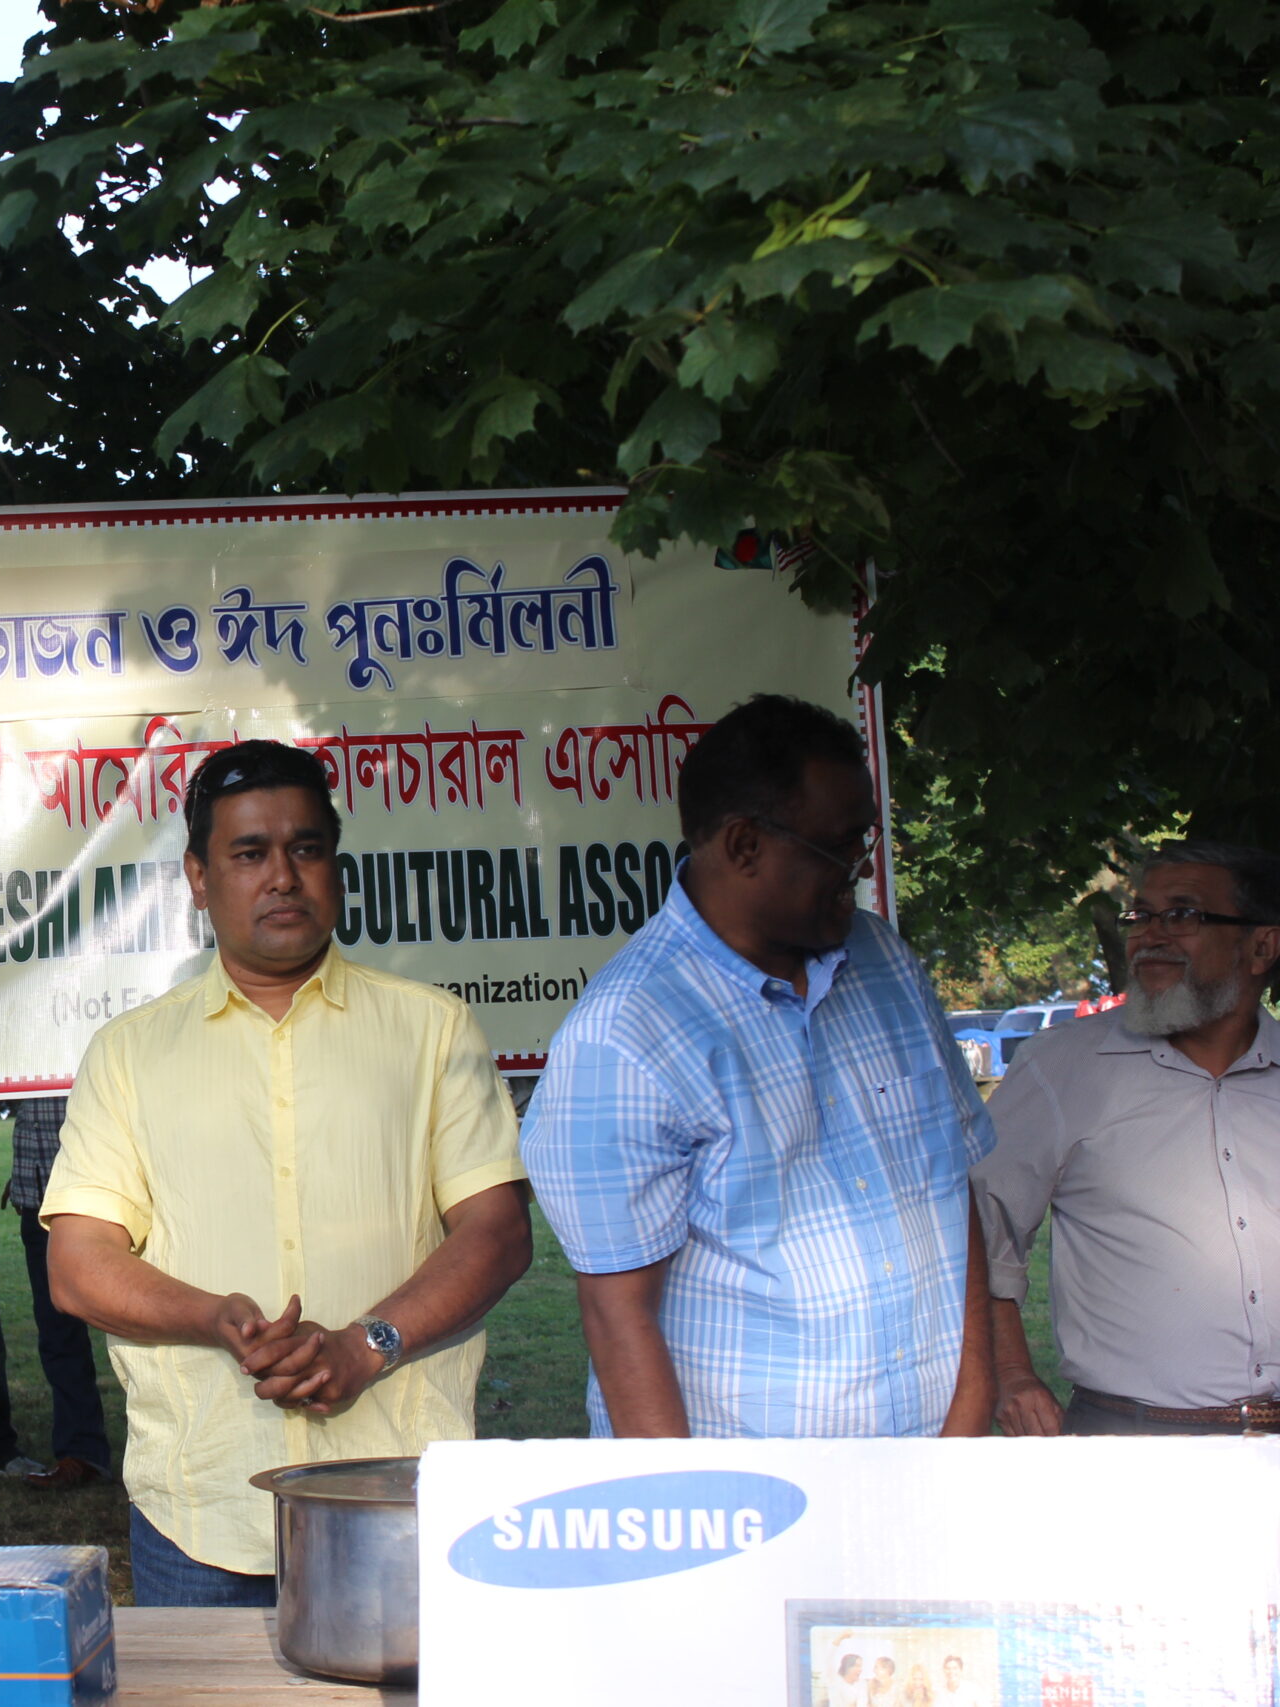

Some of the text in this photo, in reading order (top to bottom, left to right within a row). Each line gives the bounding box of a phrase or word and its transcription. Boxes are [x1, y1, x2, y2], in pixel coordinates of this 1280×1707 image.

[140, 605, 200, 675] ও
[212, 586, 308, 667] ঈদ
[336, 846, 550, 946] CULTURAL
[560, 839, 691, 937] ASSO
[490, 1507, 764, 1551] SAMSUNG
